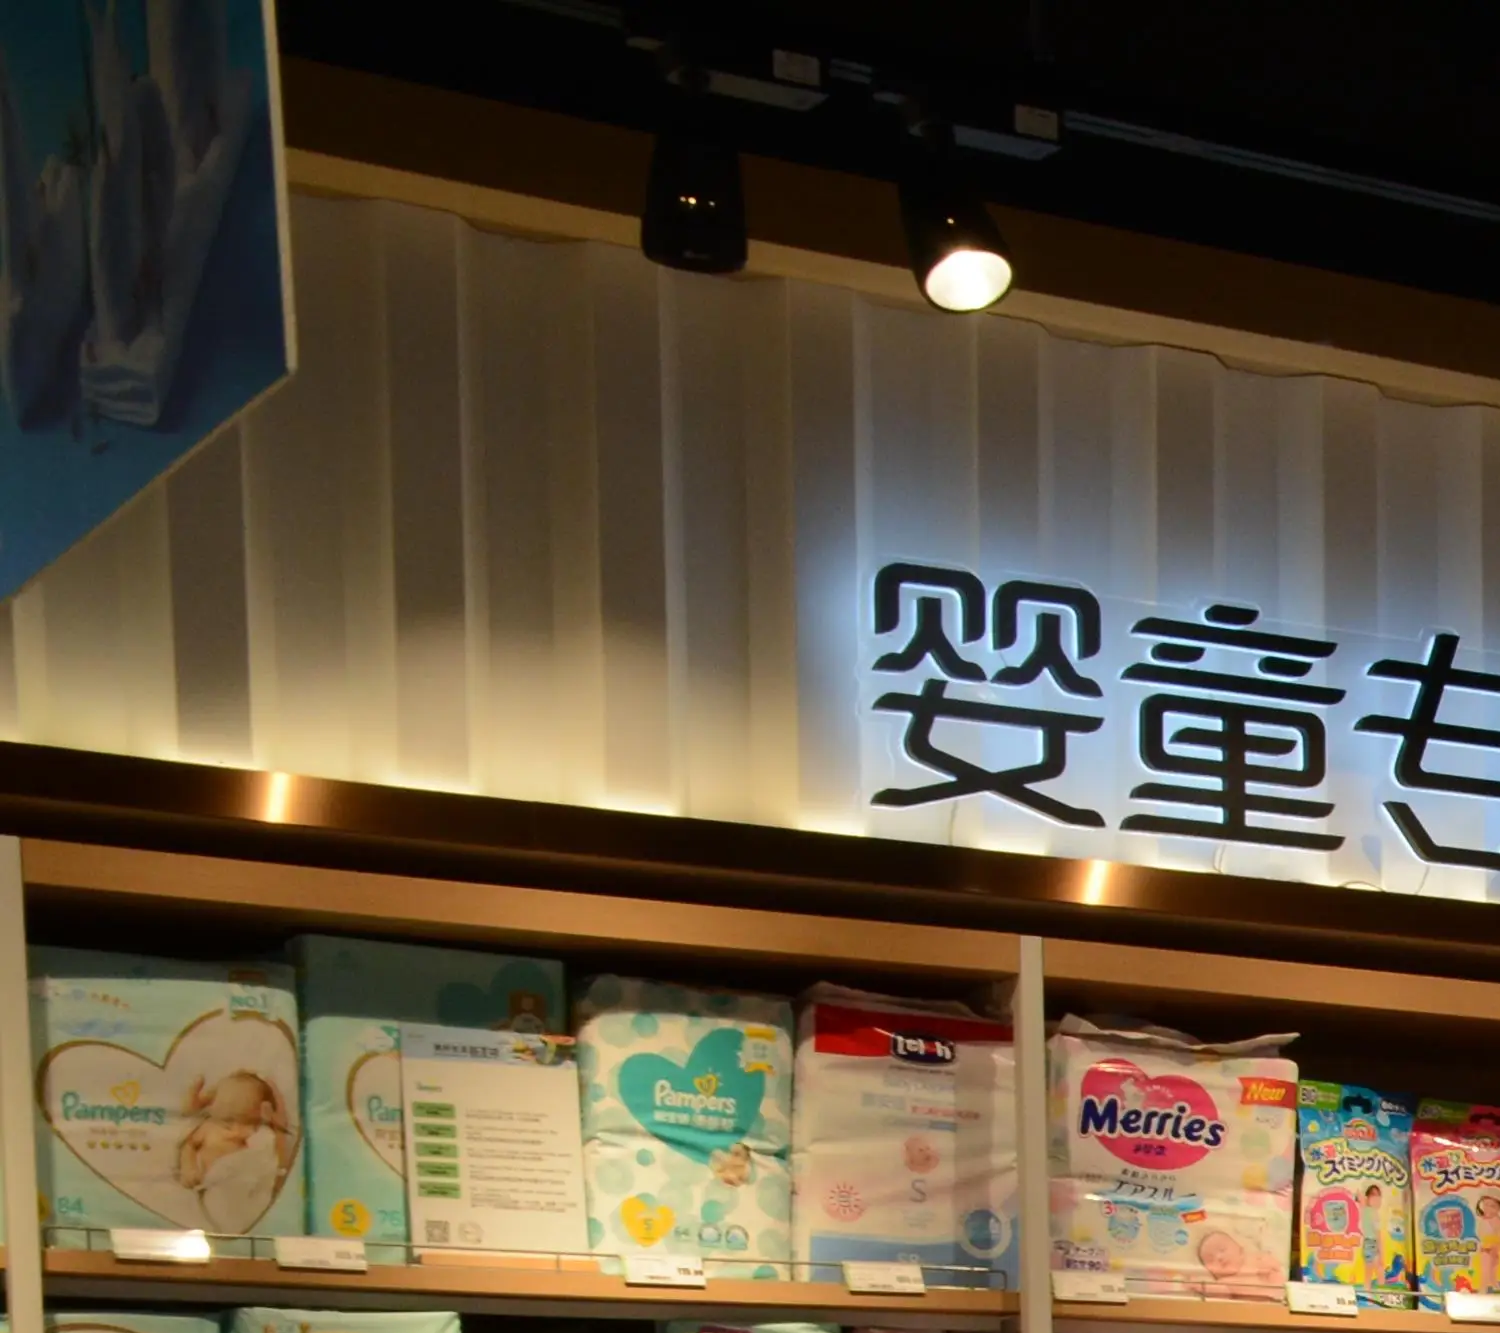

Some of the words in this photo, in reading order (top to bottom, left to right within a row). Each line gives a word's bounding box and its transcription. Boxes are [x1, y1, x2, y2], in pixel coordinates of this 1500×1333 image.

[654, 1079, 736, 1113] Pampers
[1247, 1081, 1286, 1102] New
[62, 1092, 165, 1126] Pampers
[1081, 1098, 1226, 1147] Merries
